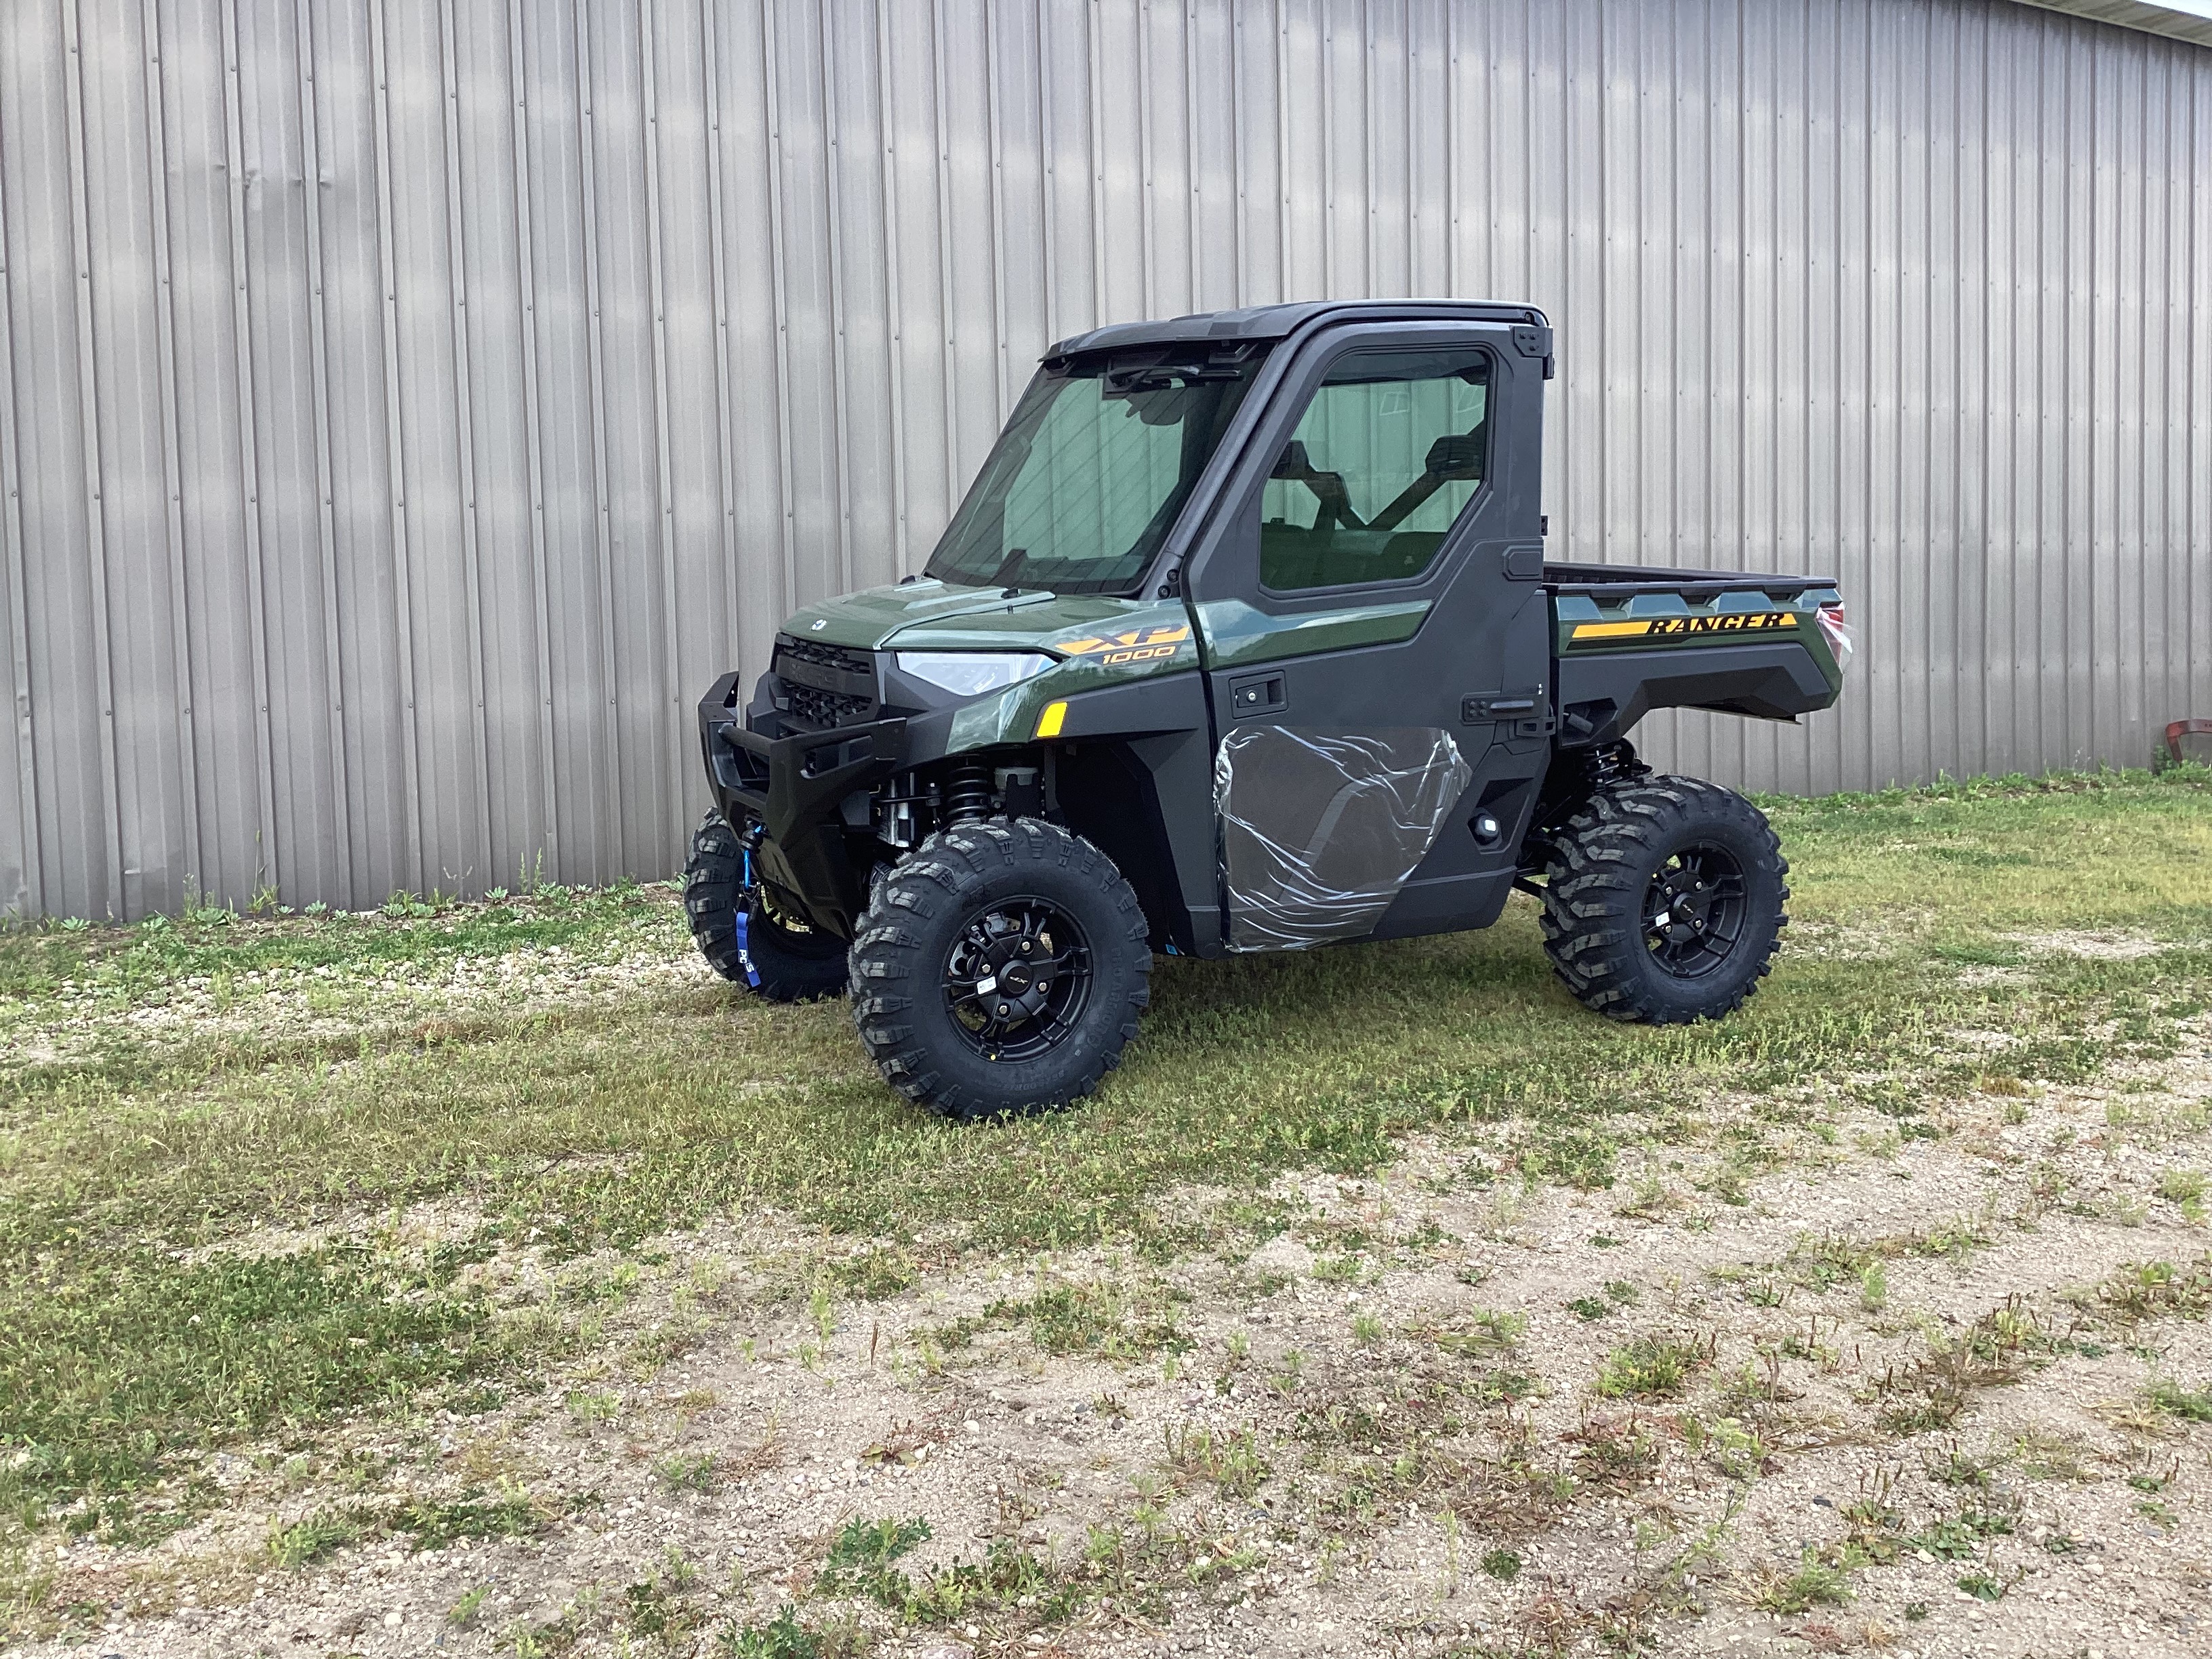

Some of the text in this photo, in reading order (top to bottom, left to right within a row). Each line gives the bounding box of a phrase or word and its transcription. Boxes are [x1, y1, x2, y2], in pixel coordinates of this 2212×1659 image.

[1645, 613, 1785, 635] RANGER
[1082, 623, 1185, 653] XP
[1103, 646, 1176, 665] 1000
